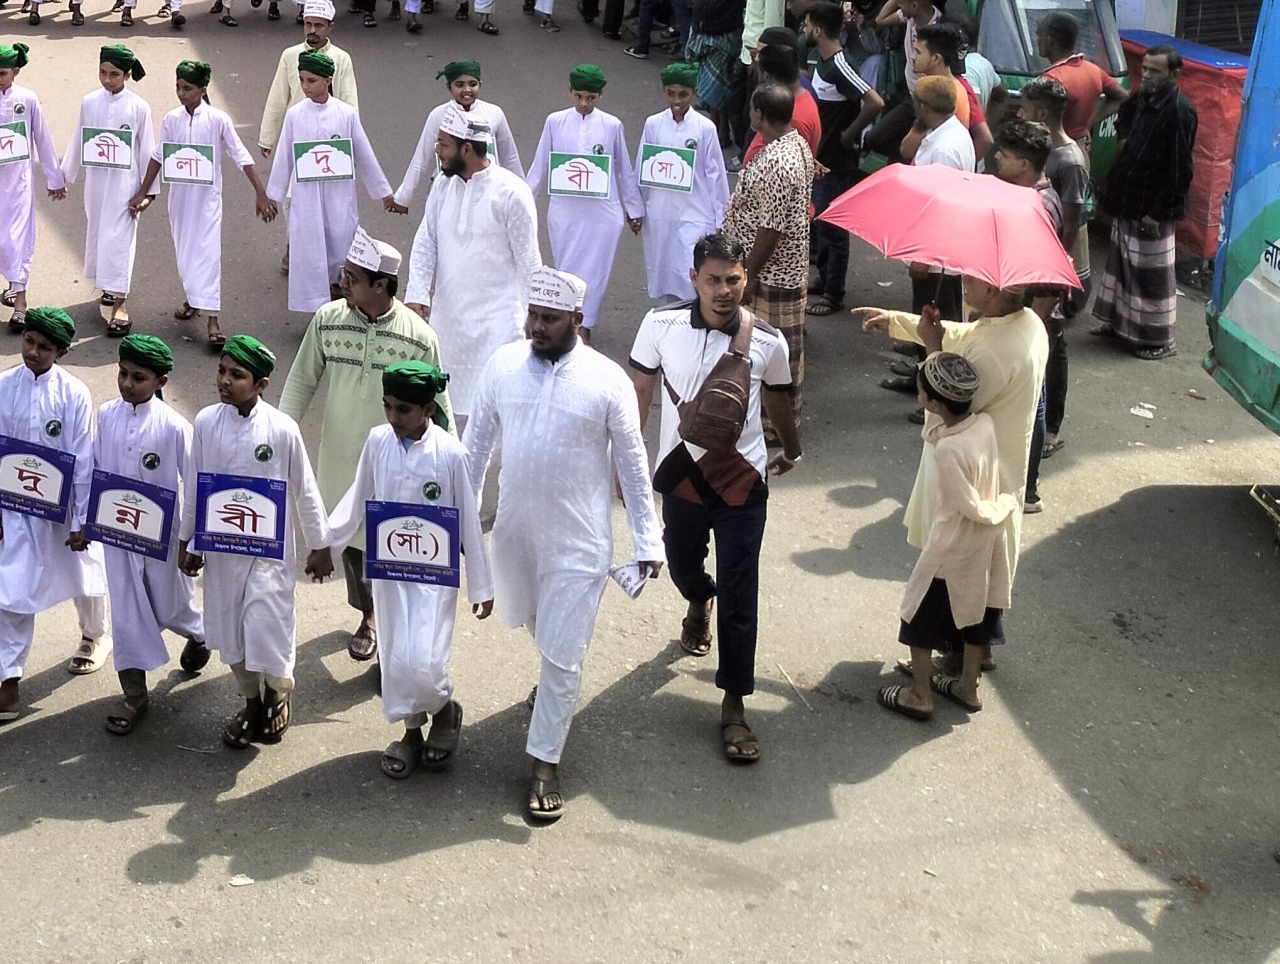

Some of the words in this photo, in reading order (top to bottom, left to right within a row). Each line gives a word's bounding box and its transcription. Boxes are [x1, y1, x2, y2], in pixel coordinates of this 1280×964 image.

[95, 135, 120, 163] মী
[310, 150, 336, 175] দু
[175, 155, 202, 178] লা
[566, 161, 593, 191] বী
[649, 155, 686, 185] (সা.)
[13, 466, 49, 498] দু
[111, 501, 149, 531] ন্ন
[216, 503, 267, 534] বী
[386, 529, 440, 561] (সা.)
